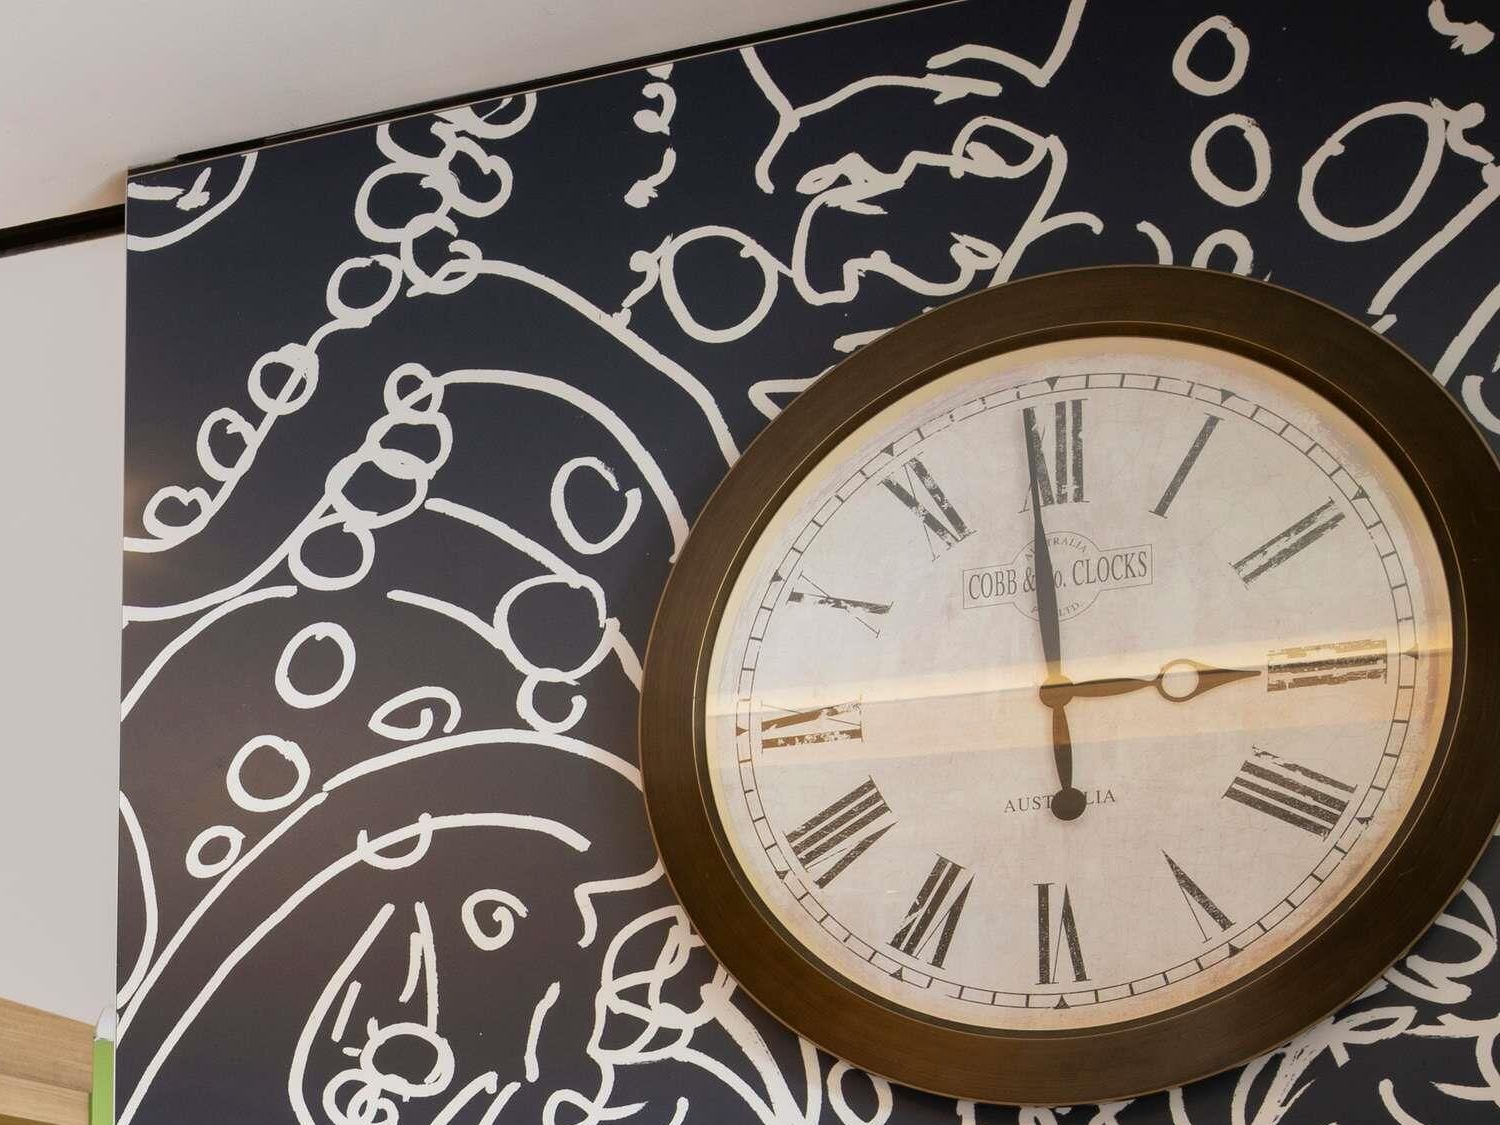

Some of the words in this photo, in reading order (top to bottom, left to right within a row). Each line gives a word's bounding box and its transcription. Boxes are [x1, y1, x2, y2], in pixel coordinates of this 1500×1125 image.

[968, 569, 1017, 600] COBB
[1022, 567, 1036, 593] &
[1071, 551, 1148, 587] CLOCKS
[1003, 789, 1116, 813] AUSTLIA
